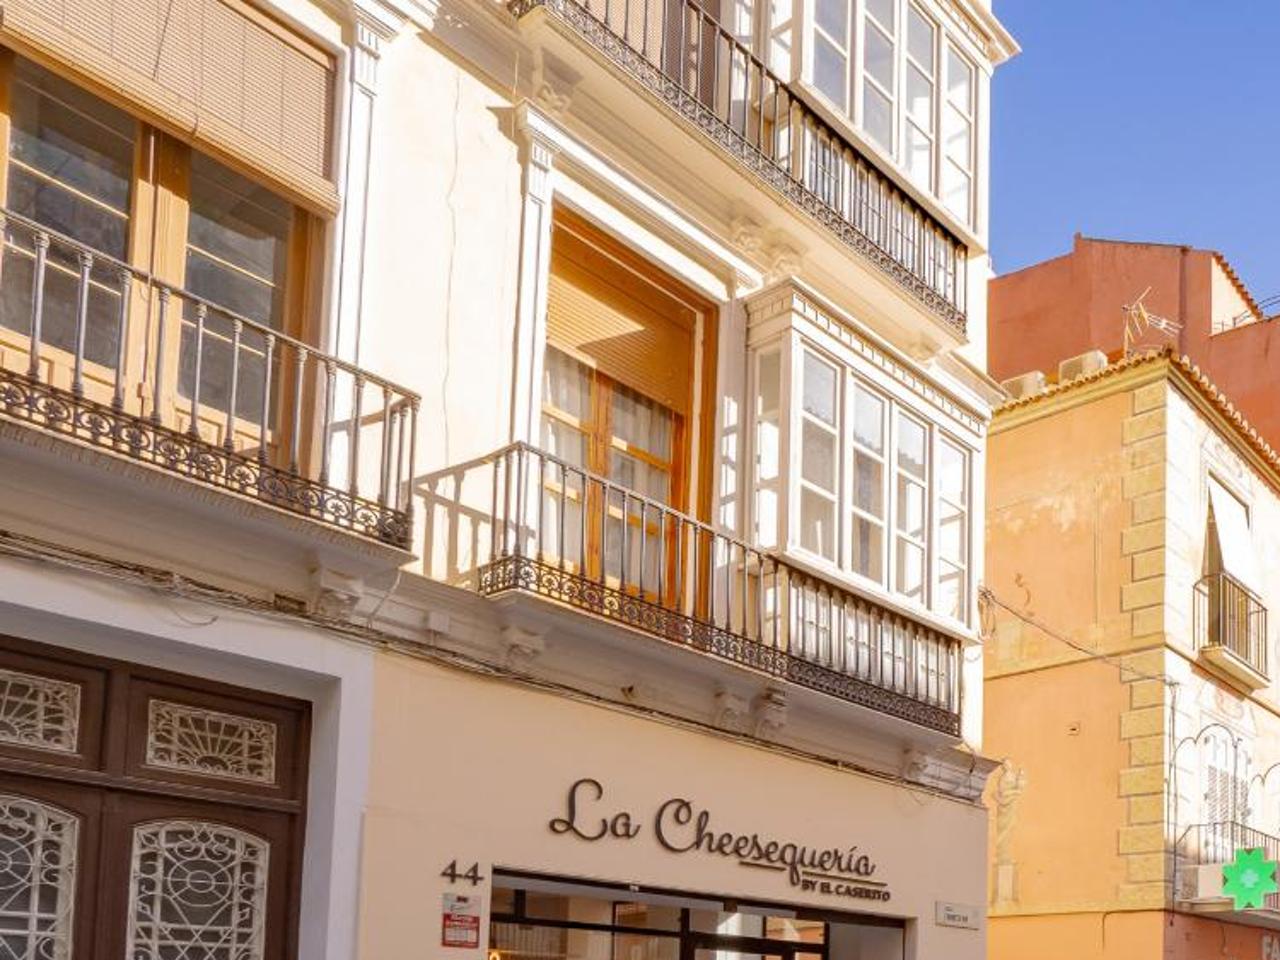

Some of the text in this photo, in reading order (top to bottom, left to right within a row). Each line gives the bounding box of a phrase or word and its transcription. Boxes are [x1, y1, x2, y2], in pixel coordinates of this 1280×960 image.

[549, 778, 876, 887] La Cheesequería
[441, 860, 484, 886] 44
[802, 879, 818, 891] BY
[820, 882, 833, 893] EL
